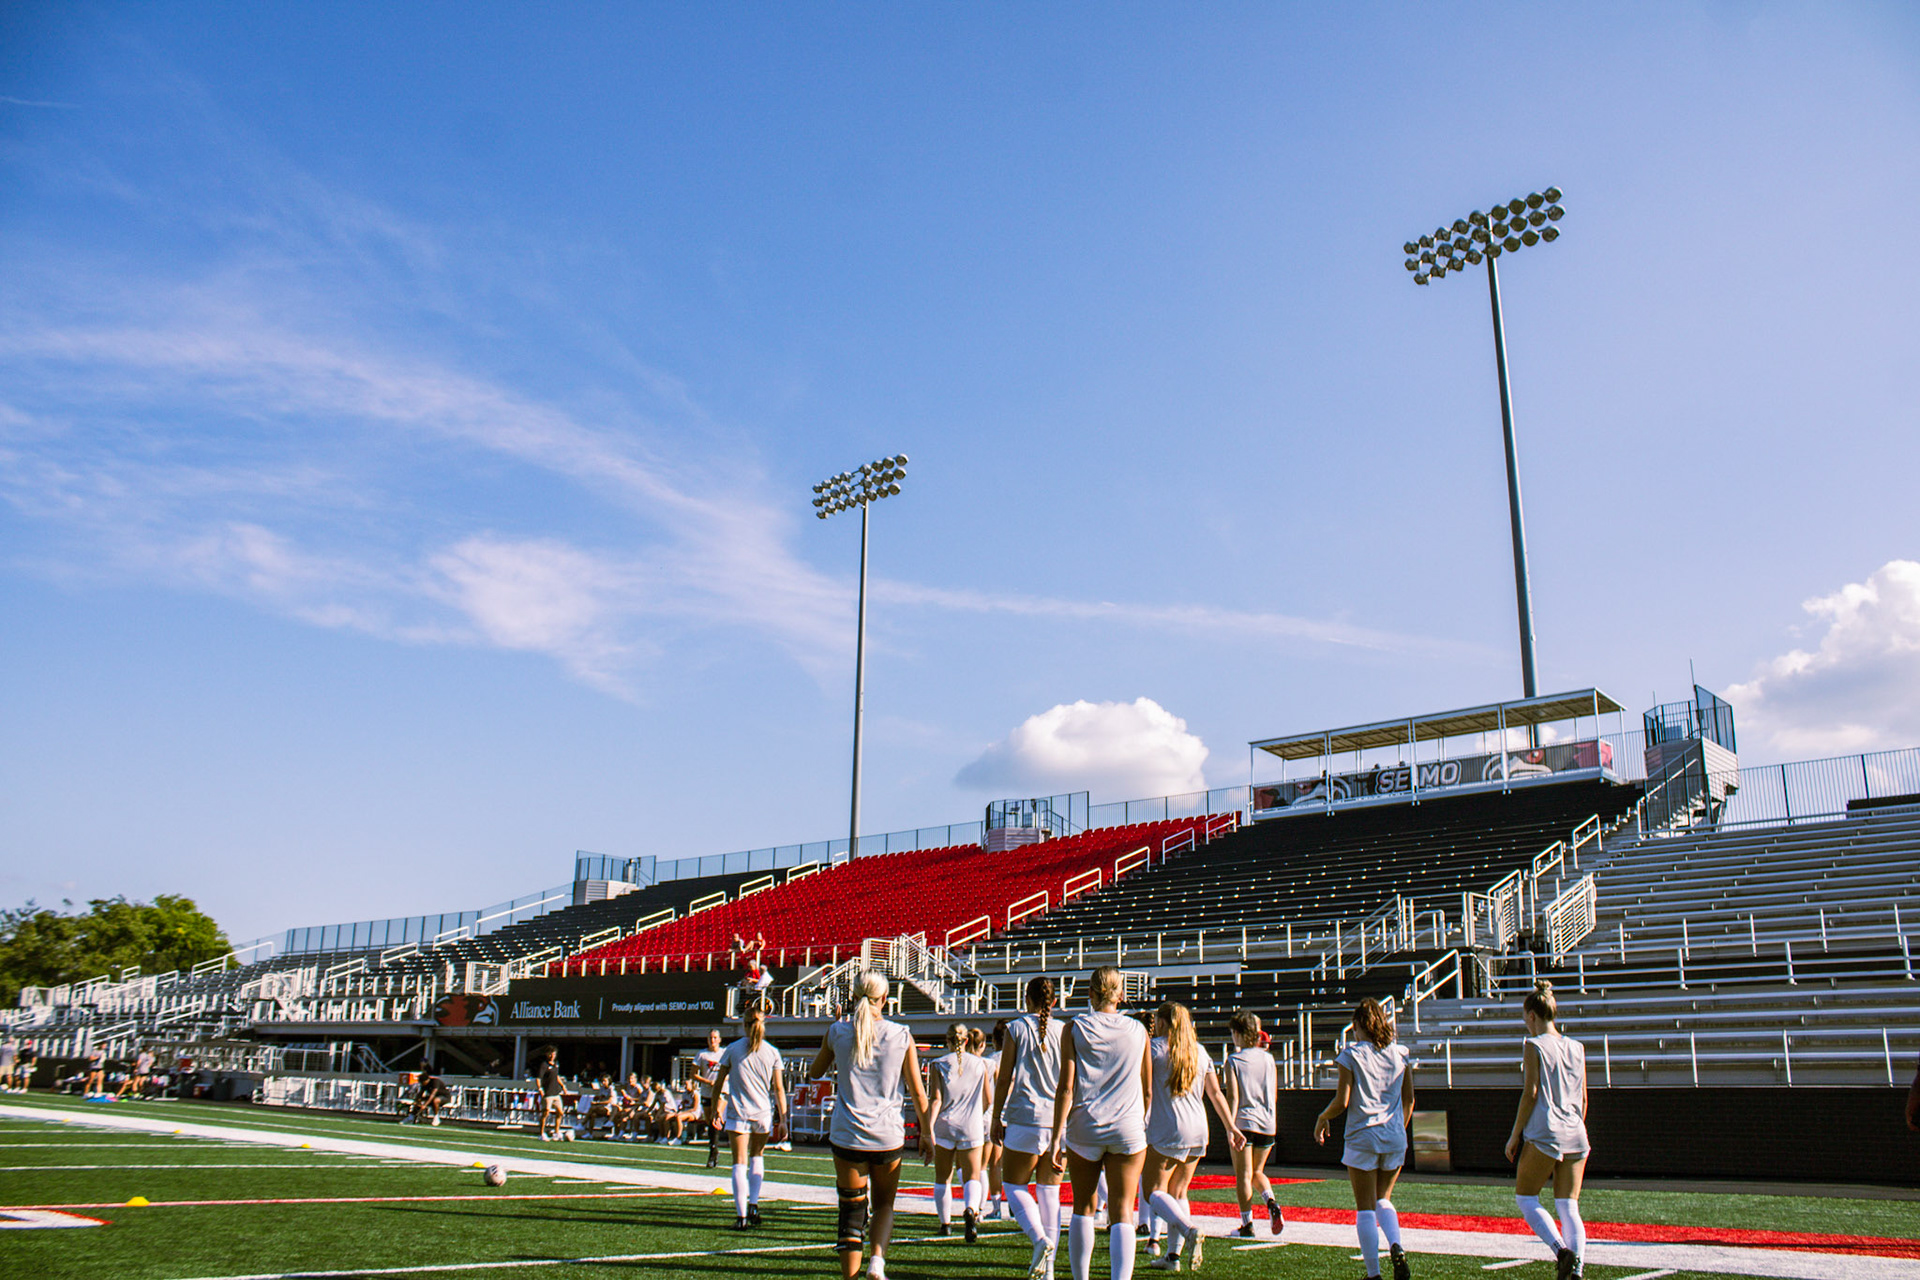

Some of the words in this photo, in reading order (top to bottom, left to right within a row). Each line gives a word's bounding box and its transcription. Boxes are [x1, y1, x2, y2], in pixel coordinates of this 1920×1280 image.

[1377, 762, 1460, 793] SEMO
[510, 1000, 551, 1019] Alliance
[553, 1000, 580, 1018] Bank
[612, 1003, 633, 1013] Proudly
[634, 1002, 654, 1013] aligned
[655, 1002, 668, 1011] with
[669, 1001, 686, 1010] SEMO
[687, 1001, 699, 1010] and
